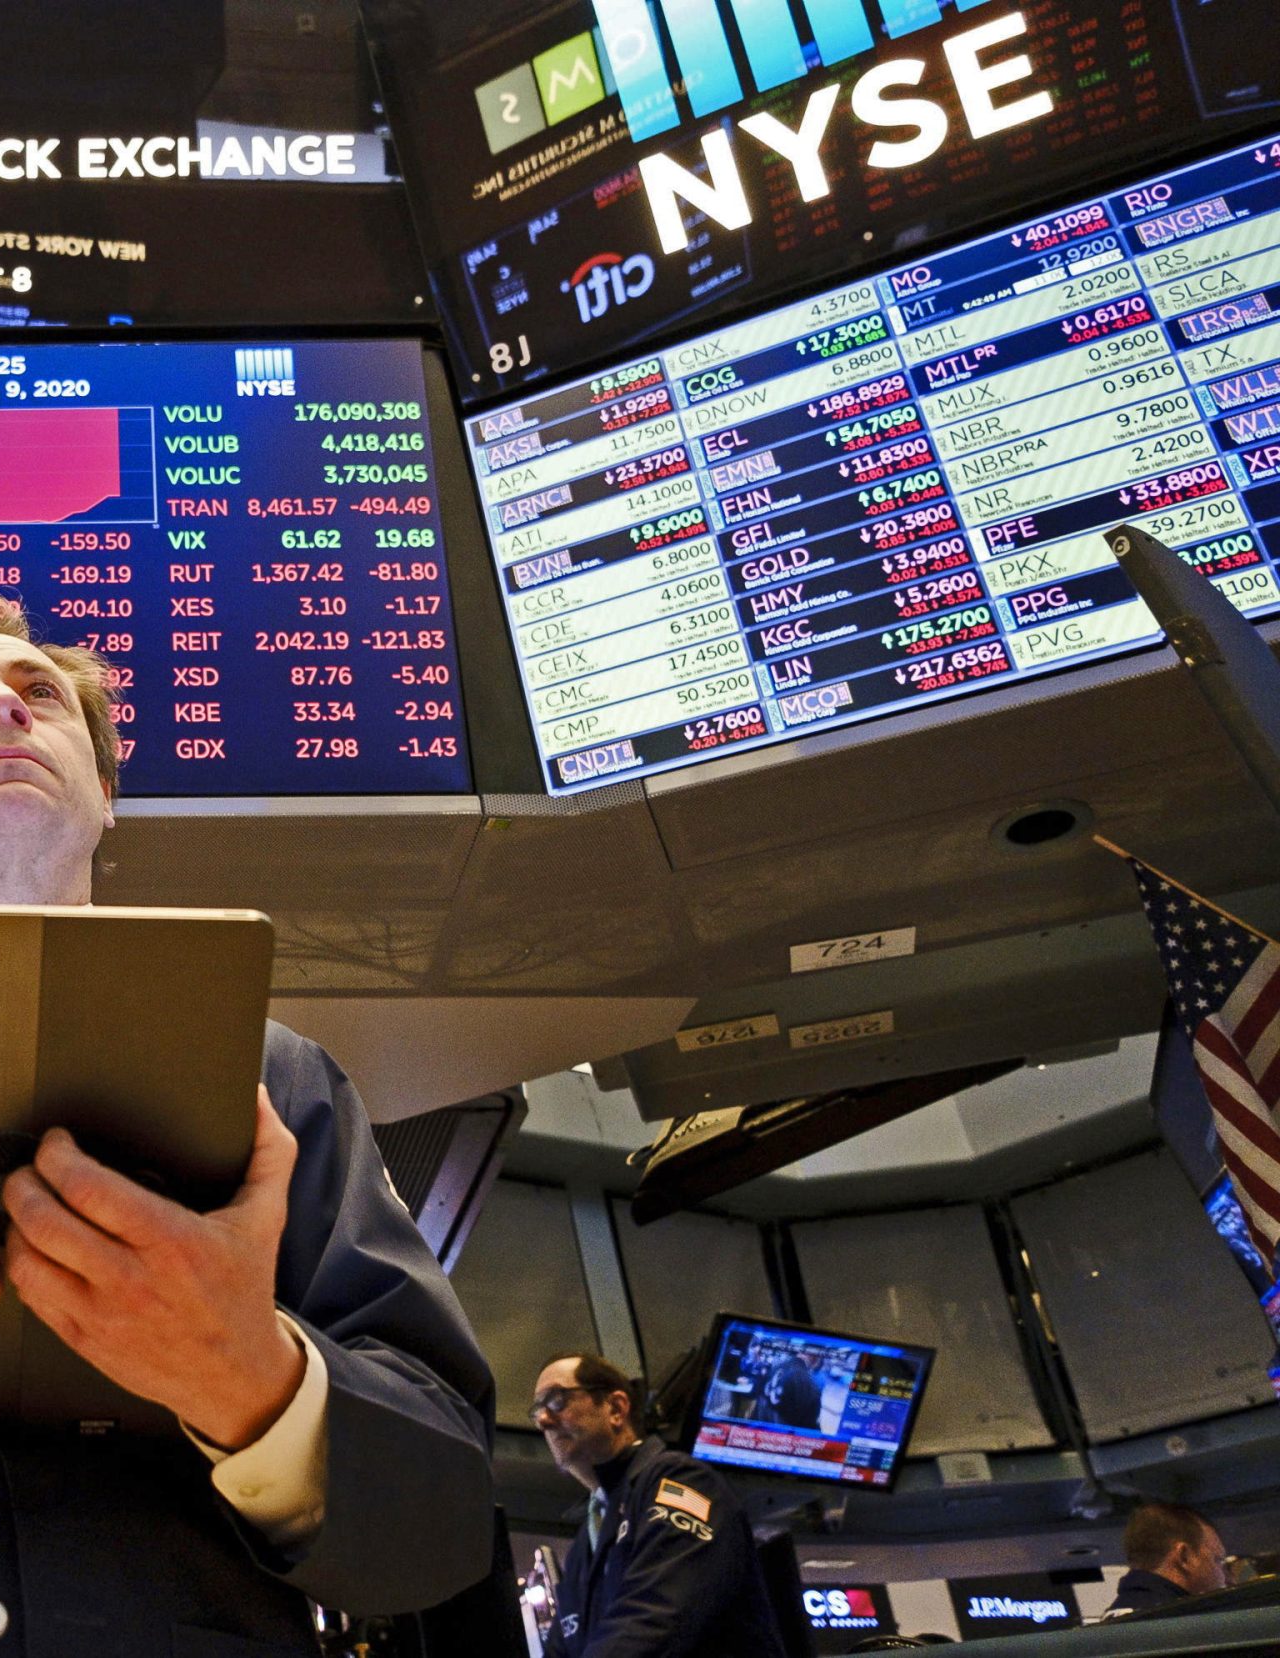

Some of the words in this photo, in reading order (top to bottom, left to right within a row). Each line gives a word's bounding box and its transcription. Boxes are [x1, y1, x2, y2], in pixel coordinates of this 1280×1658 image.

[638, 12, 1054, 255] NYSE
[78, 135, 355, 179] EXCHANGE
[1125, 184, 1172, 211] RIO
[1025, 205, 1104, 242] 40.1099
[12, 266, 32, 292] 8
[1169, 270, 1239, 303] SLCA
[1074, 296, 1146, 329] 0.6170
[236, 380, 295, 397] NYSE
[601, 360, 660, 391] 9.5900
[6, 381, 27, 399] 9,
[34, 380, 90, 397] 2020
[164, 405, 222, 423] VOLU
[294, 402, 420, 423] 176,090,308
[165, 435, 239, 453] VOLUB
[321, 433, 425, 454] 4,418,416
[949, 416, 1003, 447] NBR
[166, 467, 241, 485] VOLUC
[324, 464, 428, 485] 3,730,045
[615, 448, 686, 482] 23.3700
[167, 499, 228, 517] TRAN
[247, 498, 338, 517] 8,461.57
[349, 497, 431, 514] -494.49
[721, 487, 772, 518] FHN
[985, 516, 1038, 548] PFE
[1135, 462, 1221, 501] 33.8800
[872, 503, 952, 540] 20.3800
[50, 533, 130, 550] -159.50
[168, 531, 205, 550] VIX
[281, 530, 341, 549] 61.62
[375, 529, 435, 548] 19.68
[51, 566, 131, 584] -169.19
[170, 564, 214, 582] RUT
[252, 563, 344, 584] 1,367.42
[369, 562, 438, 581] -81.80
[741, 548, 810, 581] GOLD
[50, 600, 132, 617] -204.10
[171, 598, 214, 617] XES
[300, 597, 346, 615] 3.10
[385, 596, 441, 615] -1.17
[750, 584, 804, 616] HMY
[1011, 586, 1068, 618] PPG
[896, 606, 990, 647] 175.2700
[78, 634, 133, 652] -7.89
[172, 632, 222, 650] REIT
[255, 631, 349, 652] 2,042.19
[361, 631, 445, 649] -121.83
[668, 639, 740, 671] 17.4500
[907, 642, 1005, 682] 217.6362
[173, 667, 219, 686] XSD
[291, 666, 353, 686] 87.76
[392, 666, 449, 685] -5.40
[175, 703, 221, 722] KBE
[294, 702, 356, 721] 33.34
[395, 702, 453, 720] -2.94
[697, 708, 761, 739] 2.7600
[176, 740, 225, 759] GDX
[296, 739, 358, 758] 27.98
[398, 738, 457, 757] -1.43
[817, 935, 886, 957] 724
[670, 1510, 713, 1541] GTS
